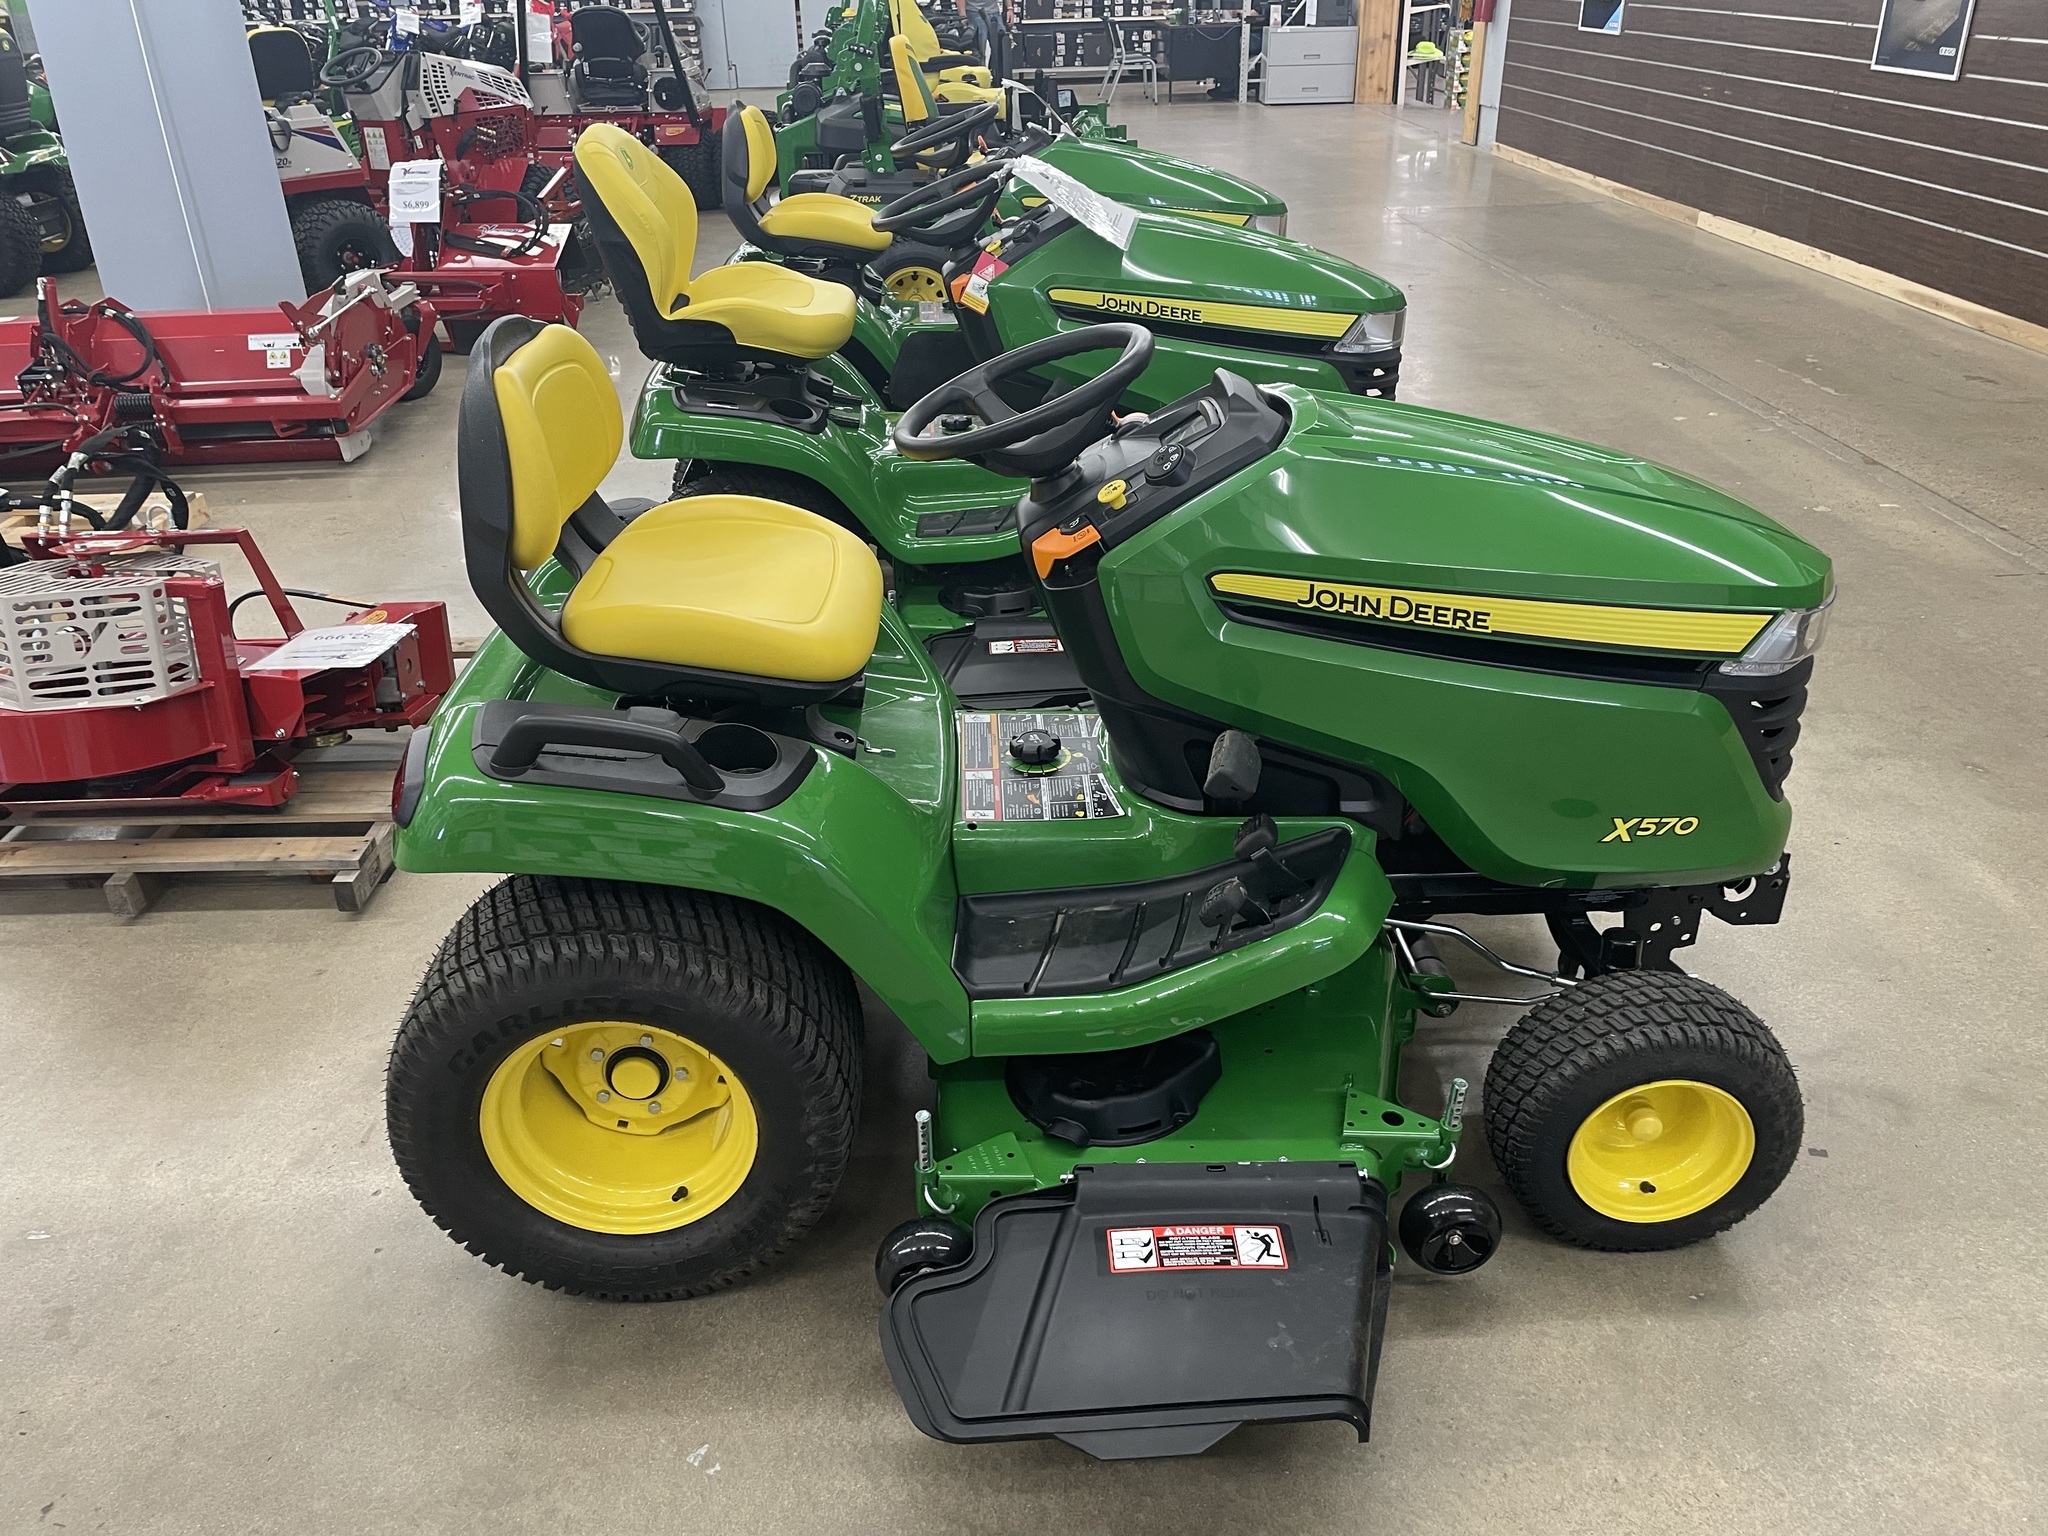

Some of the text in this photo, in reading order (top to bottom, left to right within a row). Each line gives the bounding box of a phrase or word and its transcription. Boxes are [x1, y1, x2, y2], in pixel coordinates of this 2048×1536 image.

[446, 63, 475, 80] VENTRAC
[402, 200, 430, 210] $6,899
[1096, 293, 1202, 322] JOHN DEERE
[1297, 583, 1491, 630] JOHN DEERE
[1598, 816, 1700, 843] X570
[1176, 1227, 1225, 1236] DANGER
